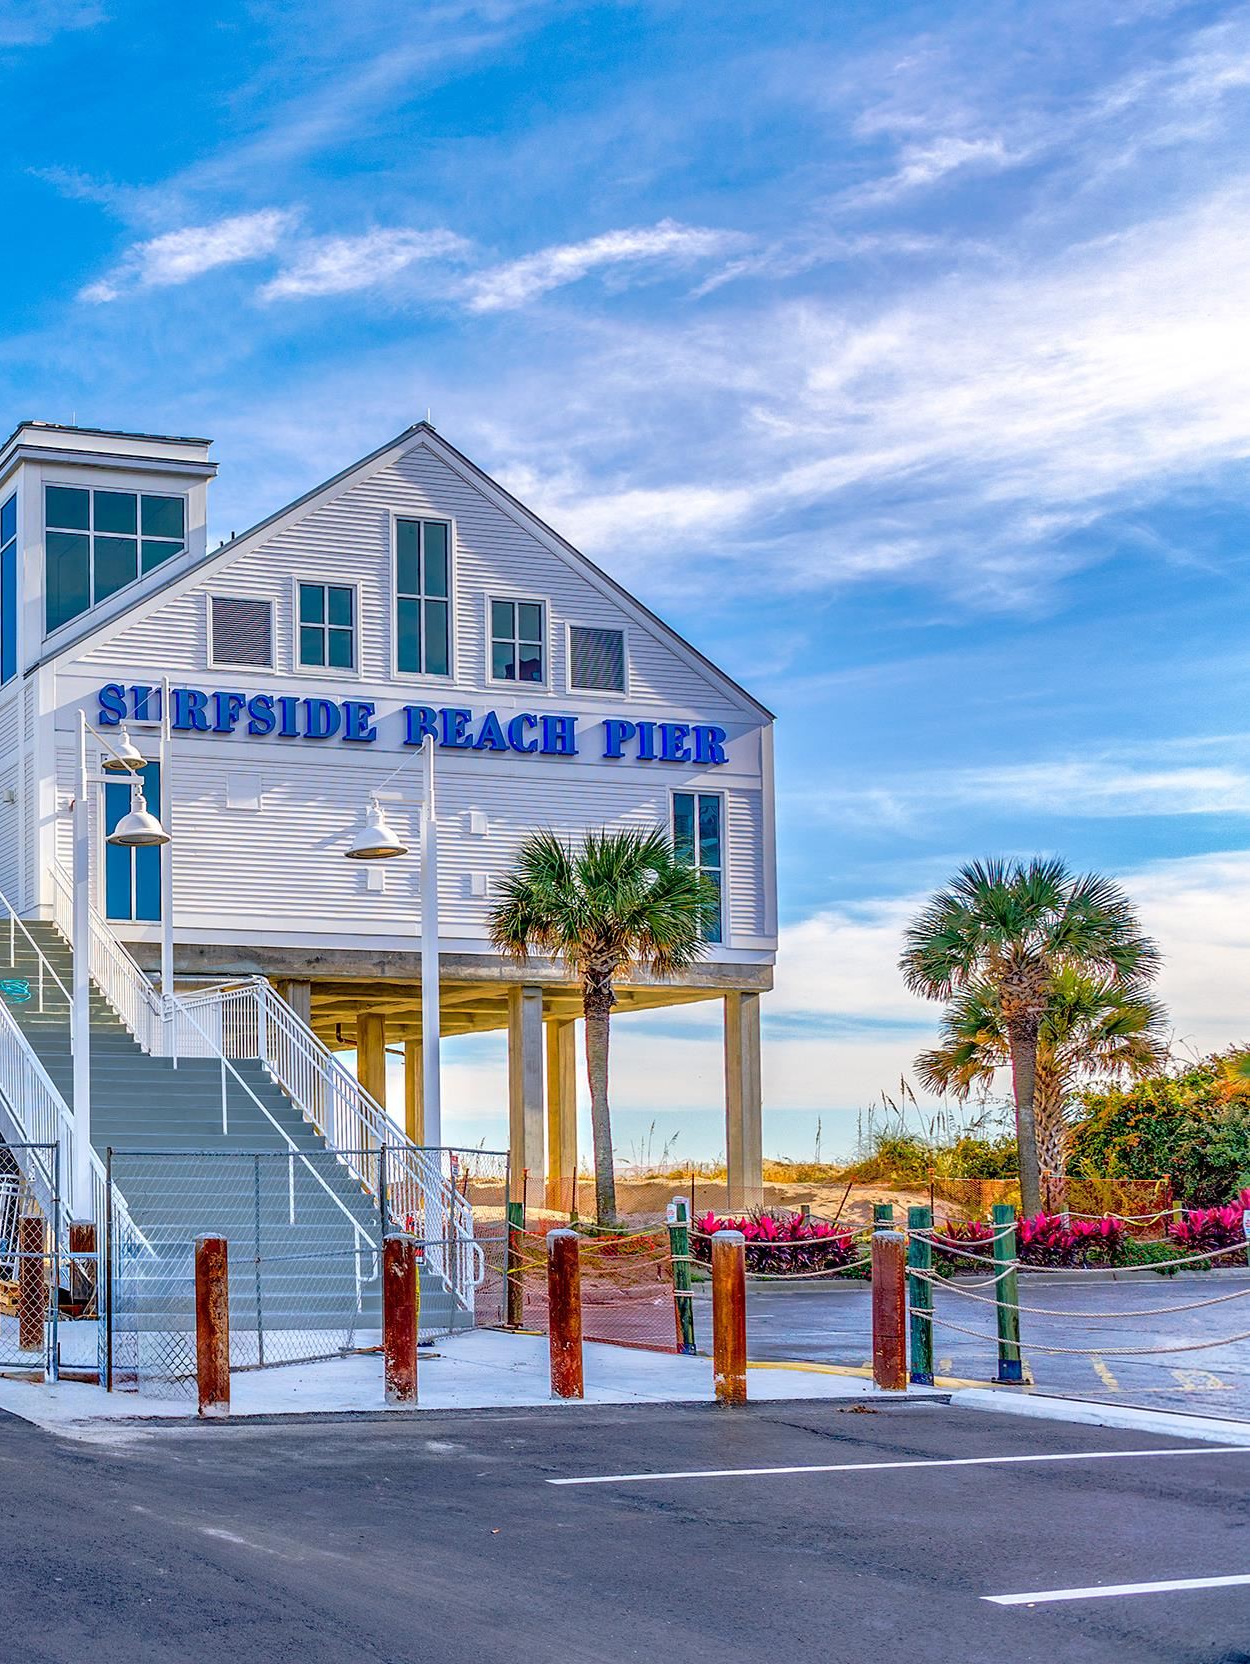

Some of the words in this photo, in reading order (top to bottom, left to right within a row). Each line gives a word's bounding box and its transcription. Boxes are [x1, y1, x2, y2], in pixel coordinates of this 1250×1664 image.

[98, 683, 377, 743] SURFSIDE
[402, 705, 579, 756] BEACH
[602, 719, 729, 765] PIER
